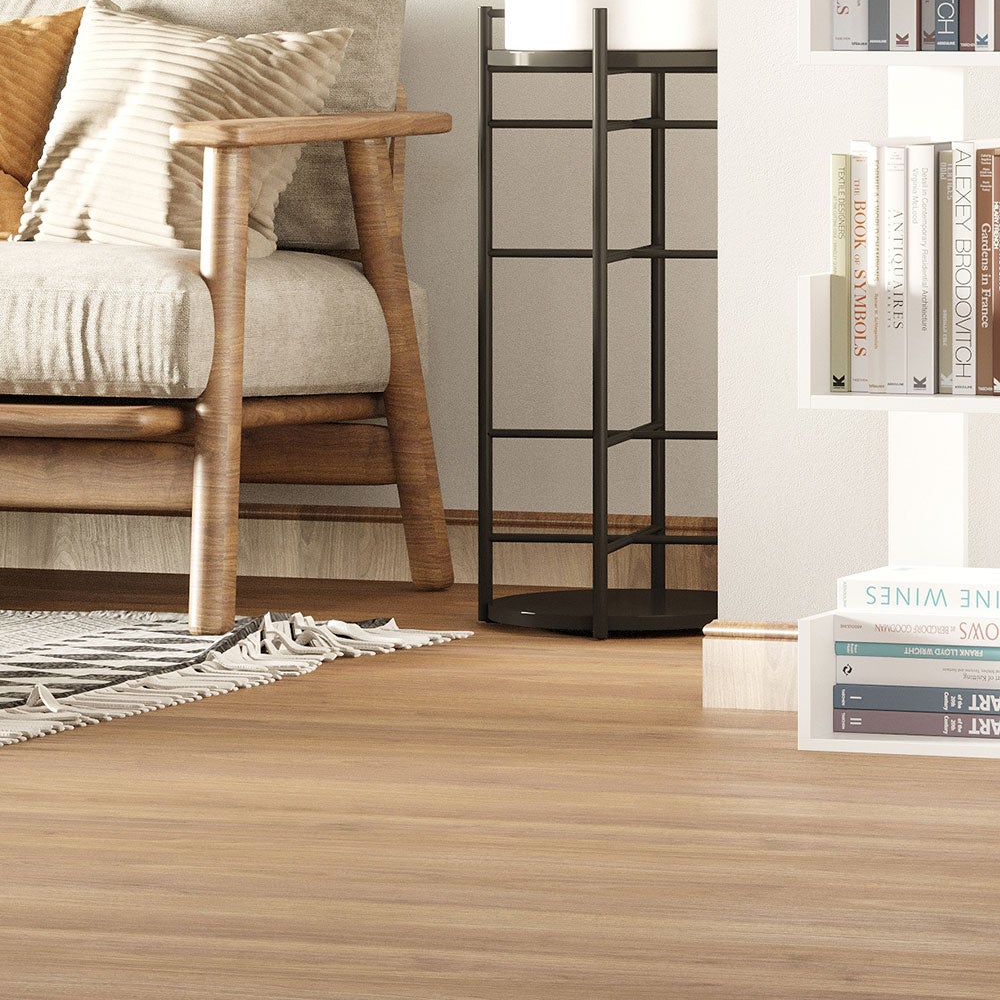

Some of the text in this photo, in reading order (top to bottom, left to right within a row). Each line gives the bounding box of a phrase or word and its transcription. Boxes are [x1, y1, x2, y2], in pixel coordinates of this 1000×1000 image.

[837, 167, 846, 240] TEXTILE DESIGNERS
[853, 200, 867, 250] BOOK
[853, 254, 860, 266] OF
[891, 209, 904, 330] ANTIQUAIRES
[955, 148, 972, 378] ALEXEY BRODOVITCH
[980, 222, 991, 328] Gardens in France
[853, 269, 867, 357] SYMBOLS
[866, 586, 947, 607] WINES
[875, 624, 912, 634] GOODMAN
[912, 624, 949, 635] BERGDORF
[904, 647, 983, 657] FRANK LLOYD WRIGHT
[963, 673, 988, 681] Knitting
